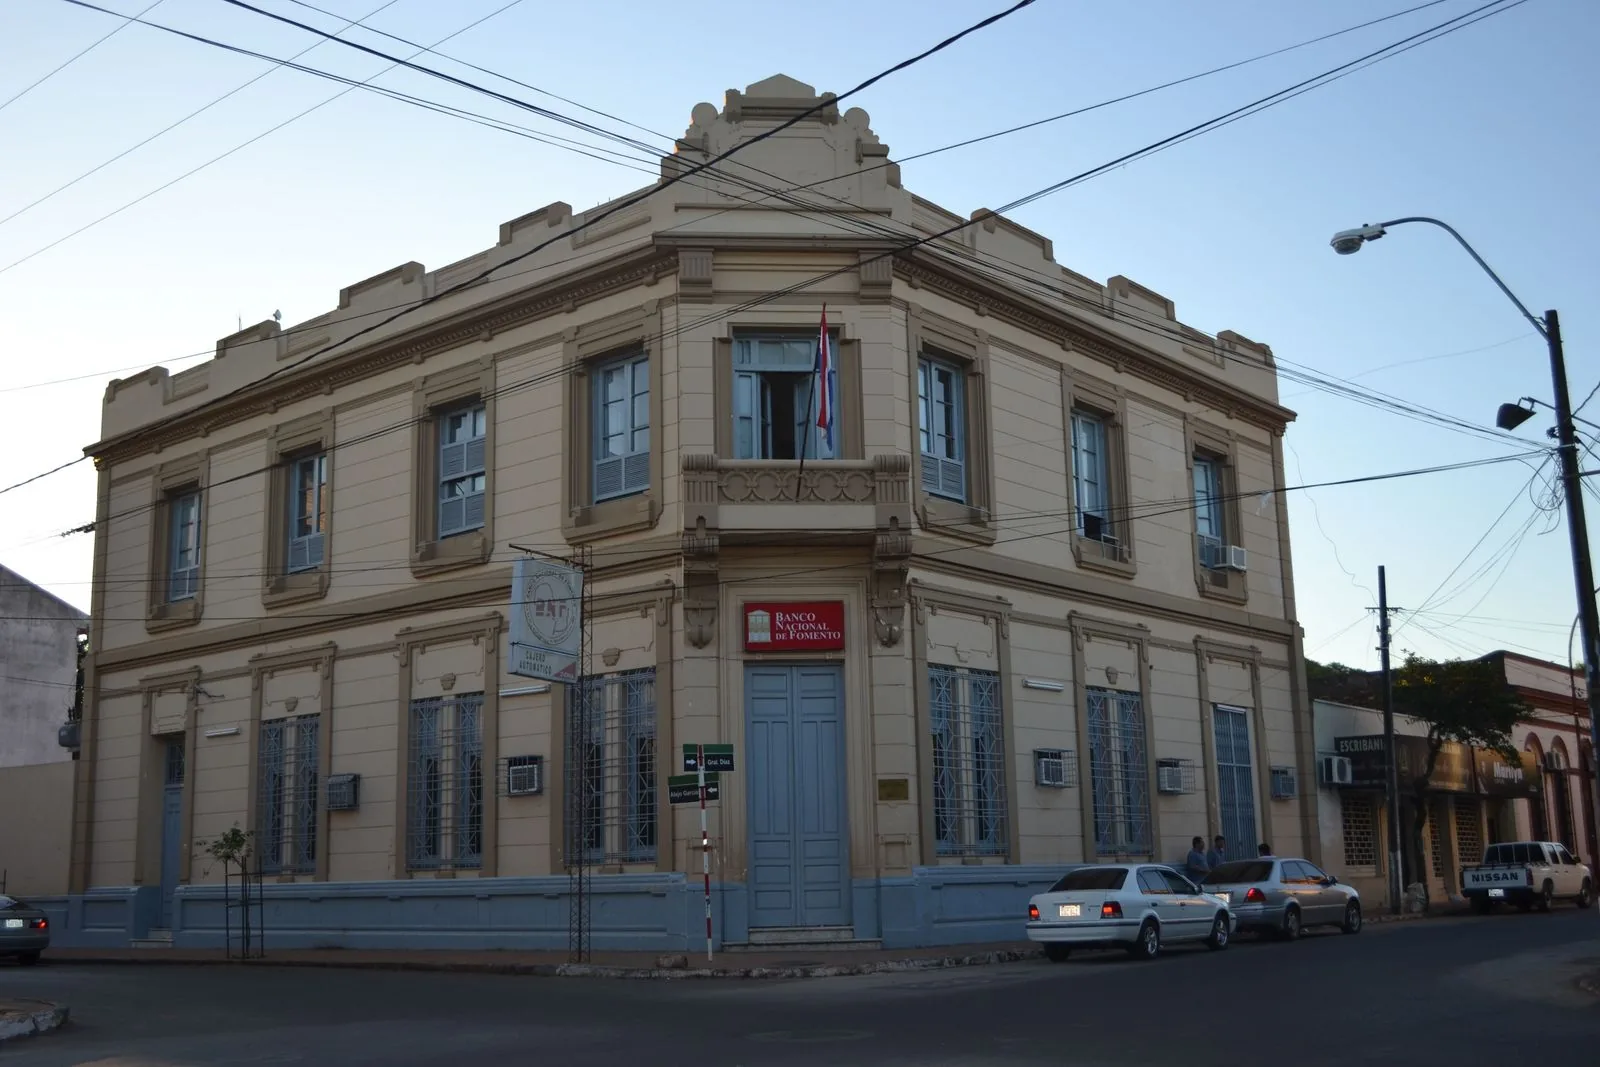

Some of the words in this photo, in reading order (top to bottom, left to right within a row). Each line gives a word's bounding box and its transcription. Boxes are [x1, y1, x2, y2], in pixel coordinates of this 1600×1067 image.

[775, 612, 816, 622] BANCO
[775, 621, 829, 631] NACIONAL
[775, 632, 788, 640] DE
[789, 630, 841, 640] FOMENTO
[525, 652, 546, 663] CAJERO
[519, 659, 552, 677] AUTOMATICO
[1340, 738, 1384, 753] ESCRIBANI
[1471, 871, 1519, 883] NISSAN
